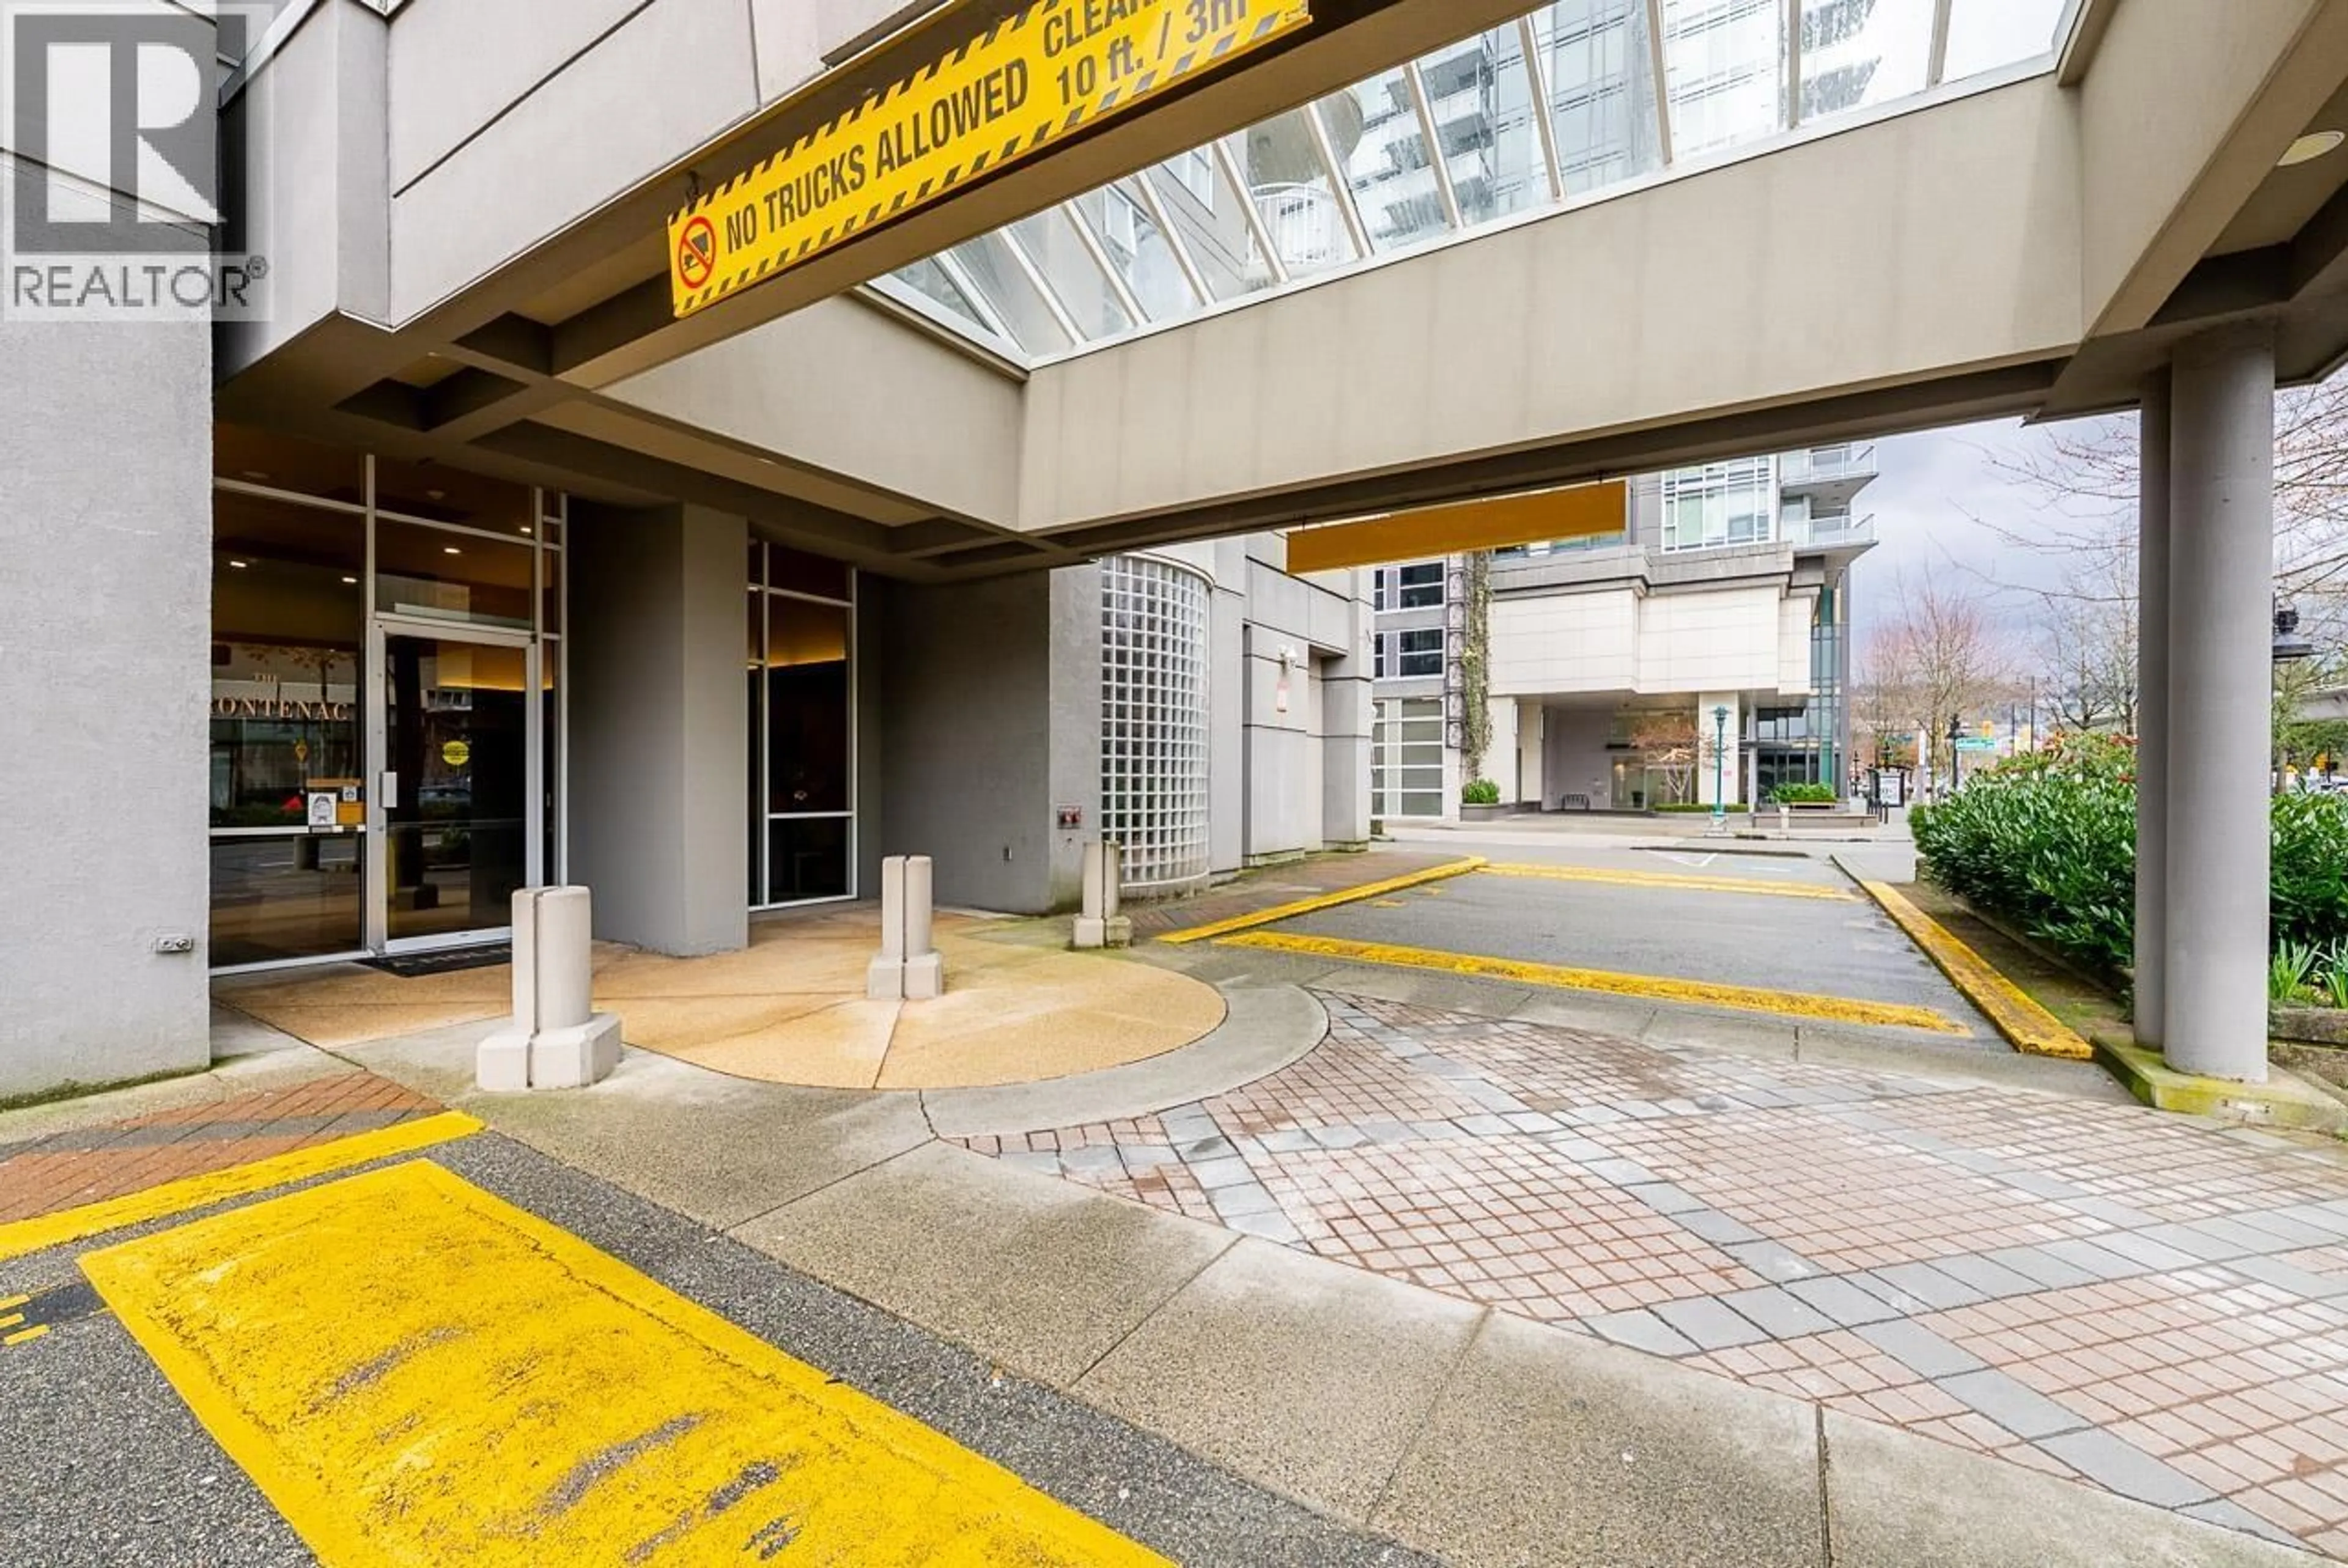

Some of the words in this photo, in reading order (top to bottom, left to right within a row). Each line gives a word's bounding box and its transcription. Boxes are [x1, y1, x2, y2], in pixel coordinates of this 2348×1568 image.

[1057, 54, 1096, 105] 10
[1107, 34, 1143, 82] ft.
[1157, 10, 1172, 61] /
[726, 203, 757, 254] NO
[763, 144, 866, 234] TRUCKS
[875, 57, 1028, 180] ALLOWED
